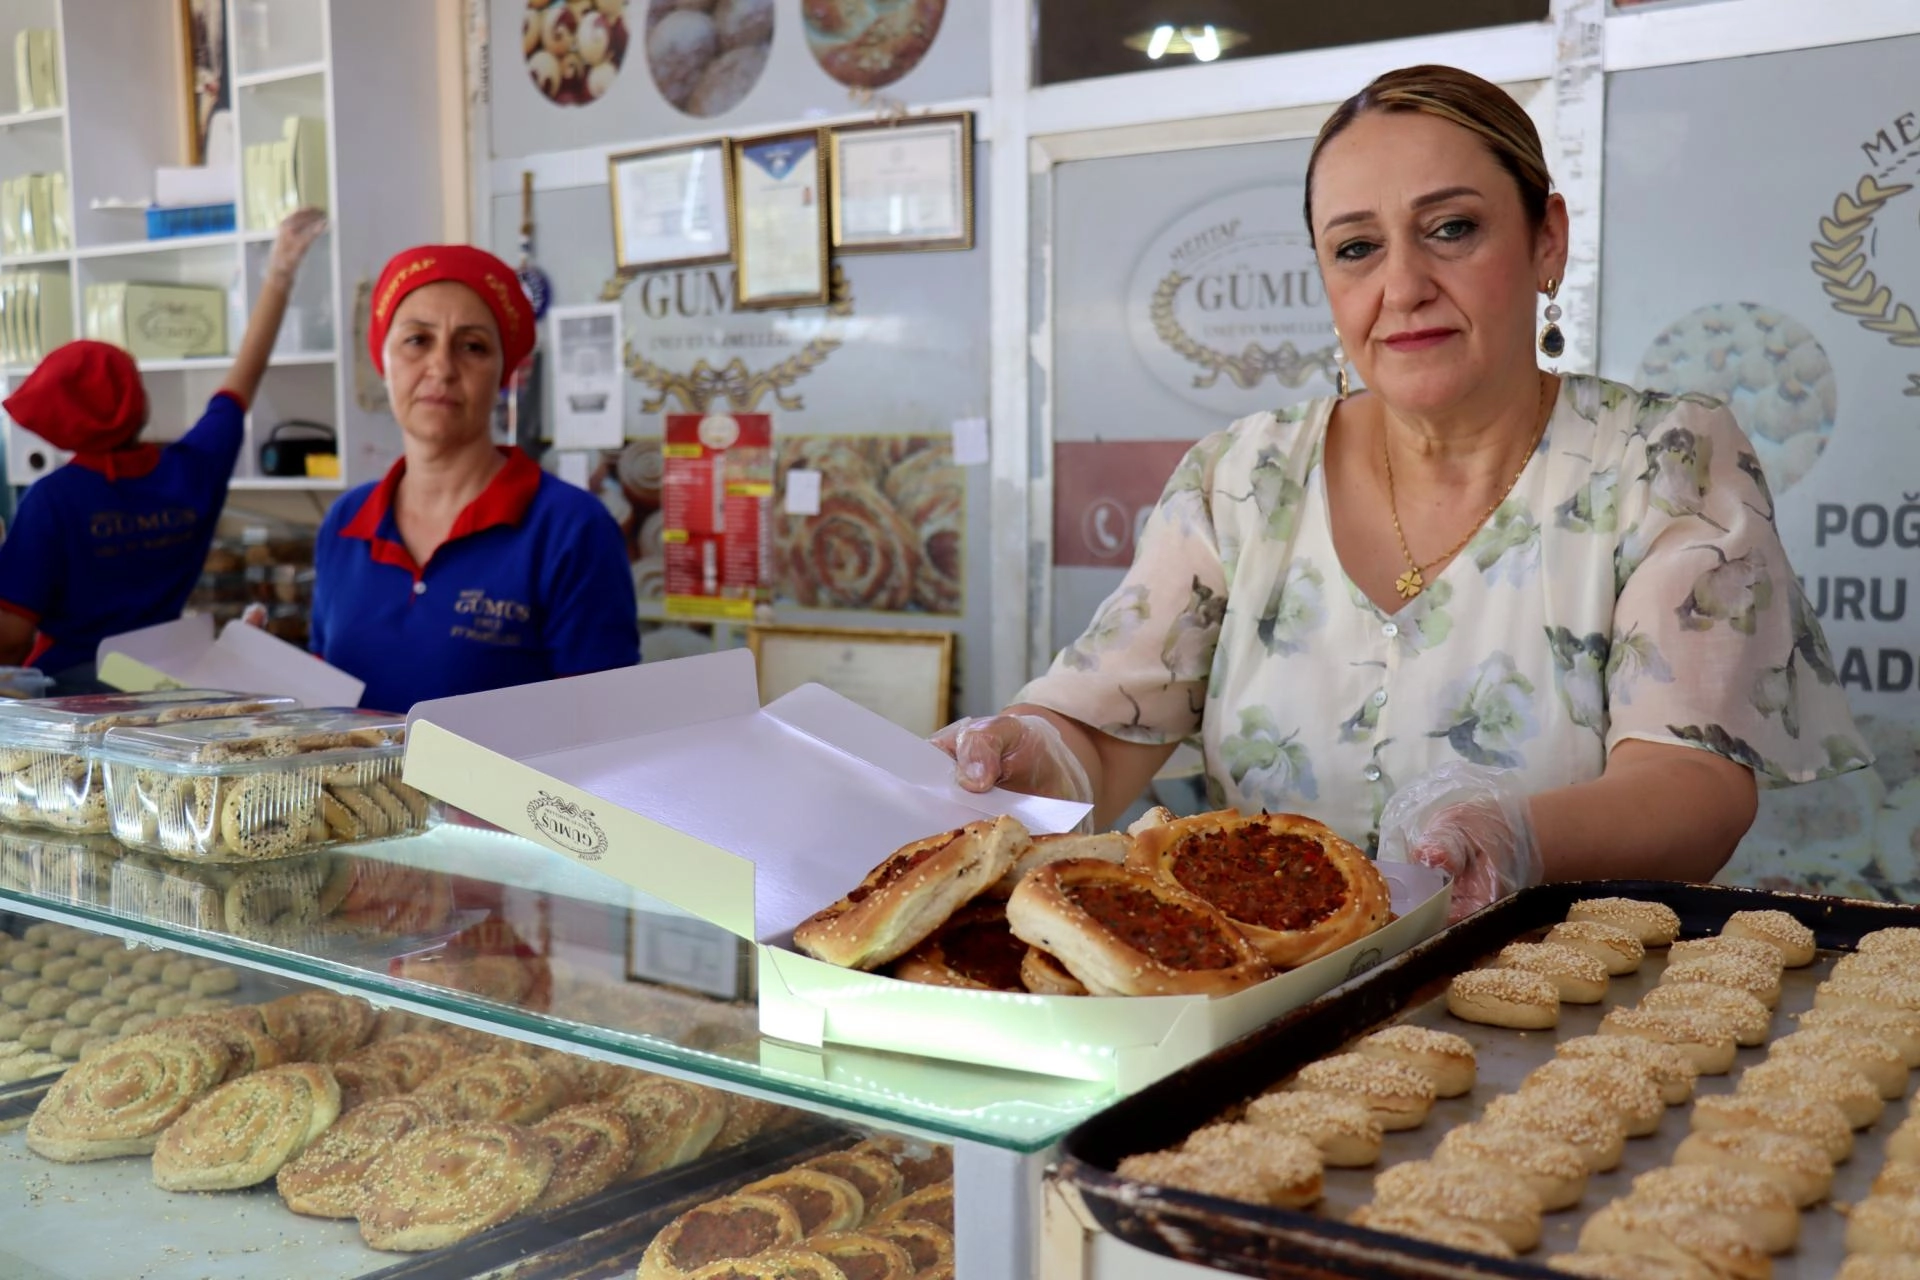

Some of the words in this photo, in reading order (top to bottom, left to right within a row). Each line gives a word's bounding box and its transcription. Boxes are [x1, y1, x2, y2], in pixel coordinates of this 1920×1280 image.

[1195, 260, 1325, 313] GÜMÜ
[1815, 491, 1920, 549] POĞ
[1801, 576, 1908, 622] URU
[1840, 646, 1920, 693] AD
